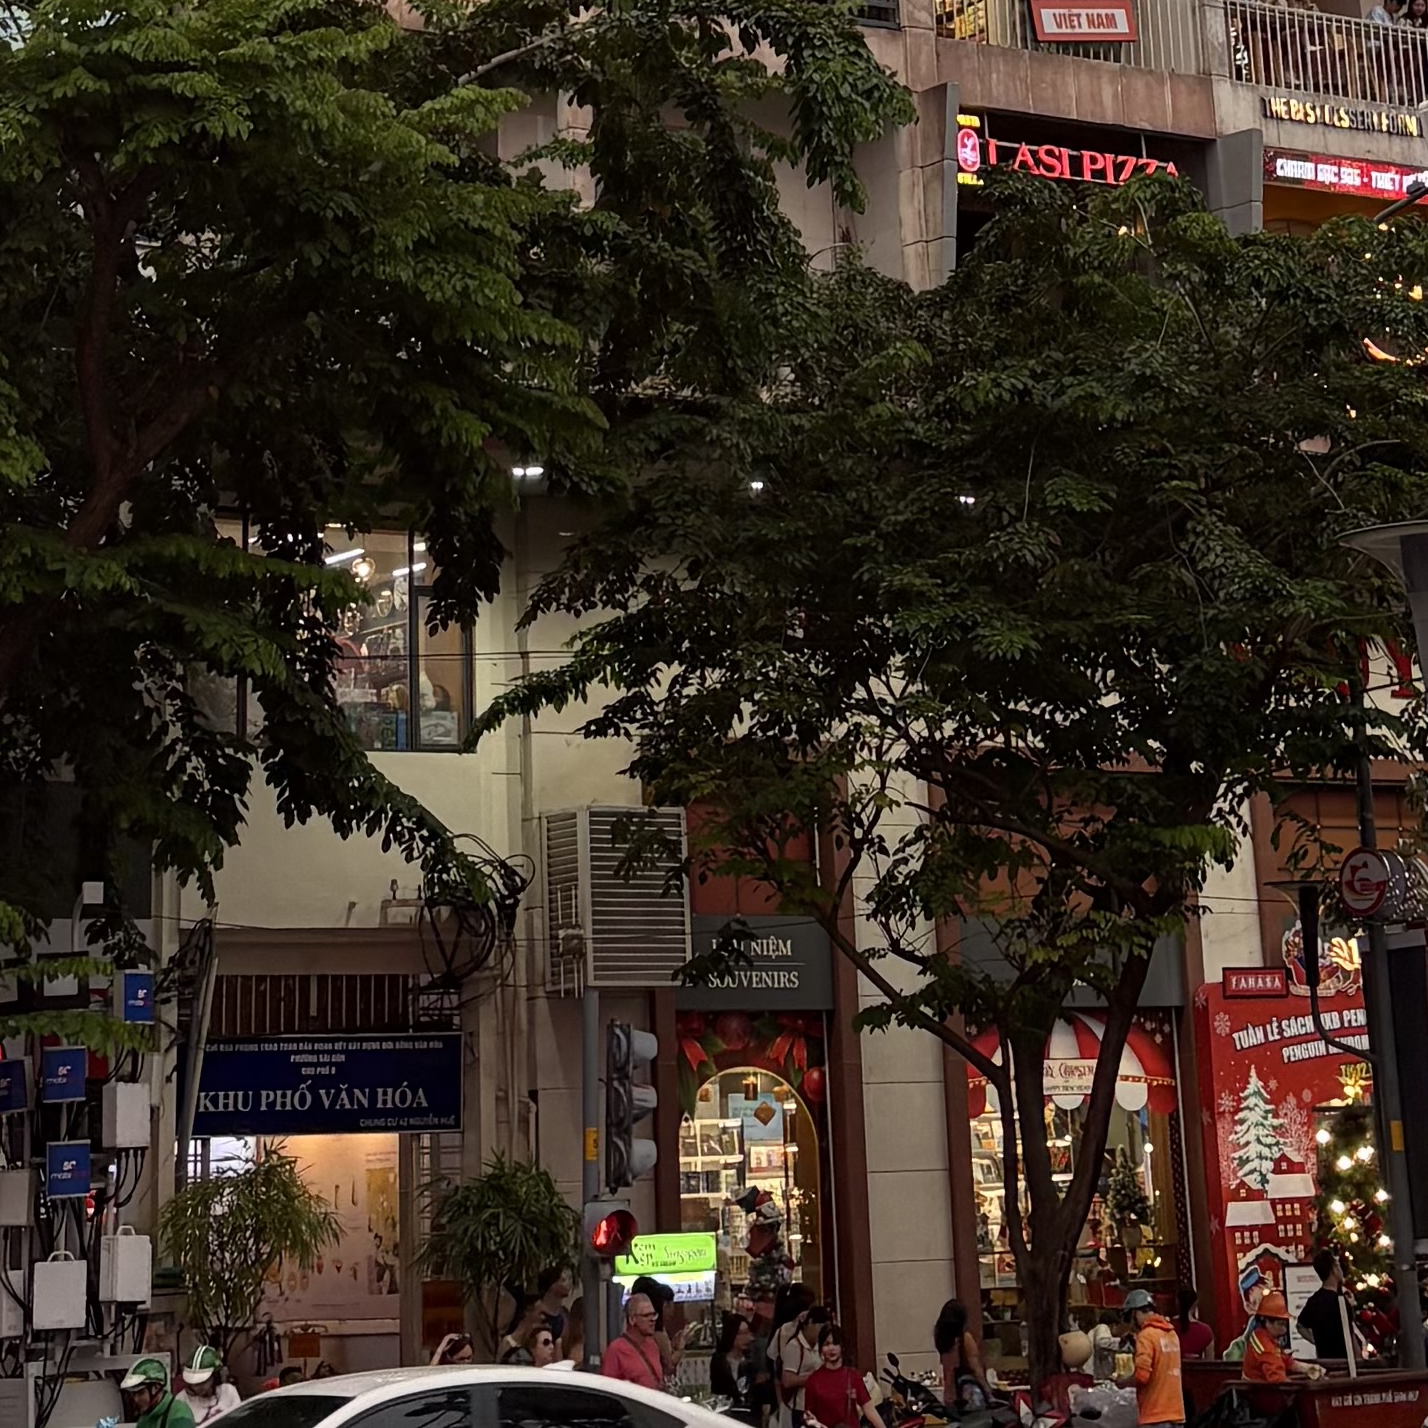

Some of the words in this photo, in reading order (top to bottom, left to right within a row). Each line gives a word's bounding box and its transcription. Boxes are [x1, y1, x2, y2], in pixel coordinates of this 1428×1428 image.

[1085, 12, 1119, 30] NAM
[1079, 149, 1180, 187] PIZZ
[707, 970, 800, 989] SOUVENIRS
[1281, 1014, 1315, 1038] SÁCH
[1282, 1040, 1327, 1064] PENGUIN
[197, 1091, 253, 1113] KHU
[259, 1080, 313, 1112] PHỐ
[318, 1083, 370, 1111] VĂN
[375, 1081, 429, 1110] HÓA
